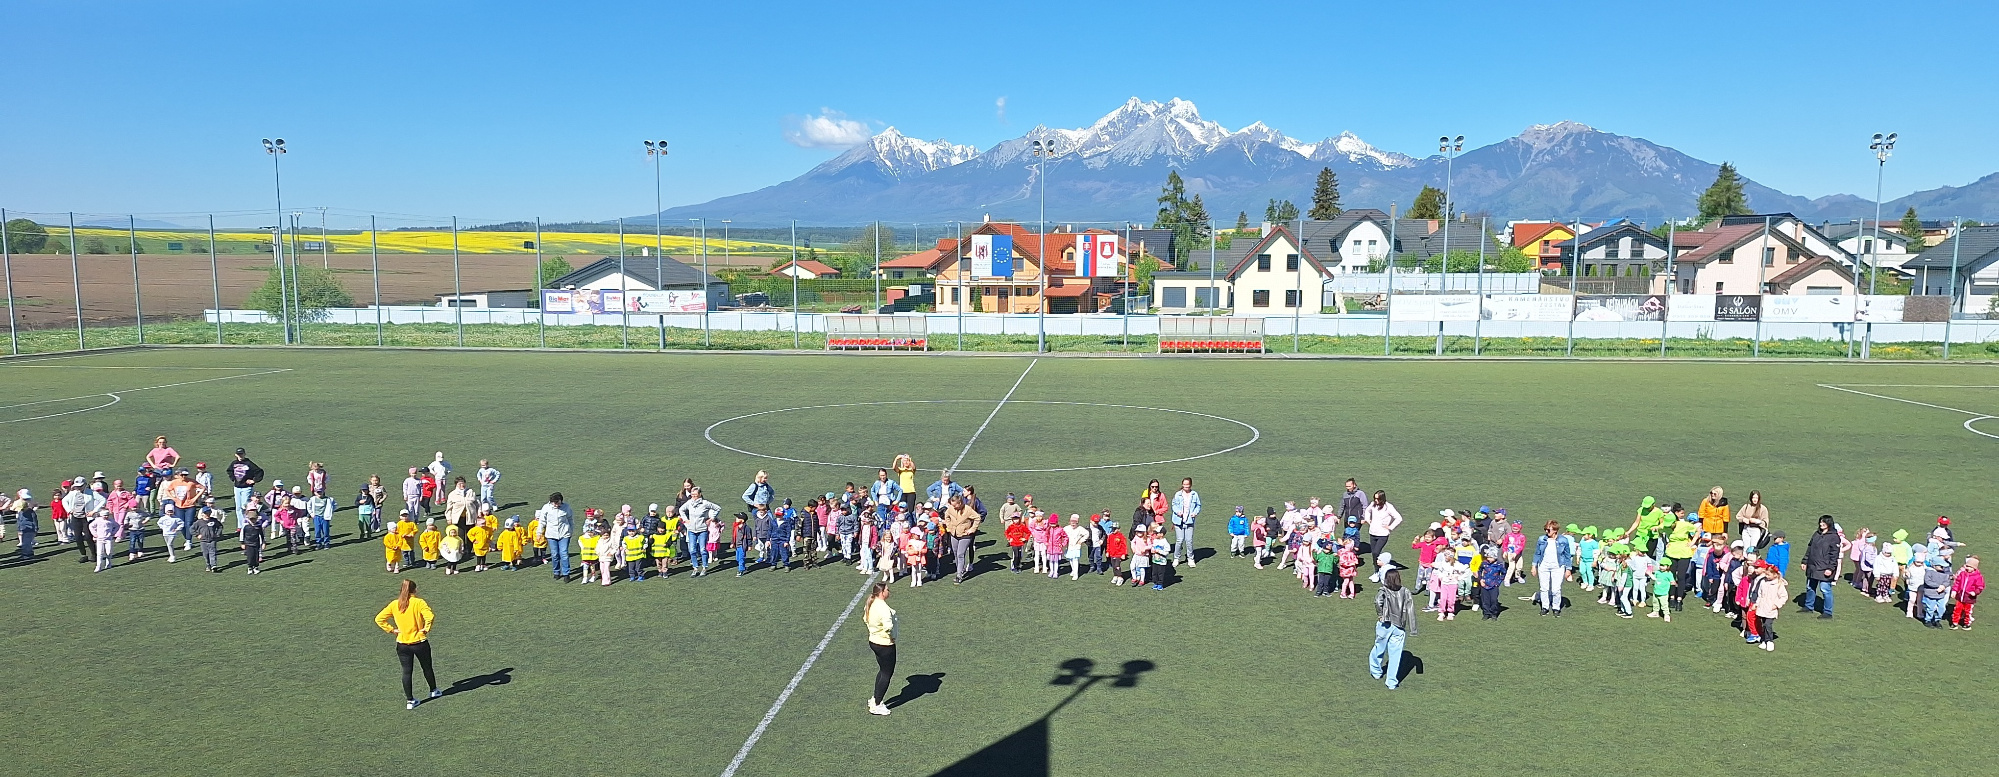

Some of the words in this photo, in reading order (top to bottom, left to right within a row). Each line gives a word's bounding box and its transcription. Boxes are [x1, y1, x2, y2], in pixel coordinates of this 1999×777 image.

[1717, 306, 1728, 315] LS
[1729, 305, 1758, 315] SALÓN
[1773, 307, 1799, 315] OMV
